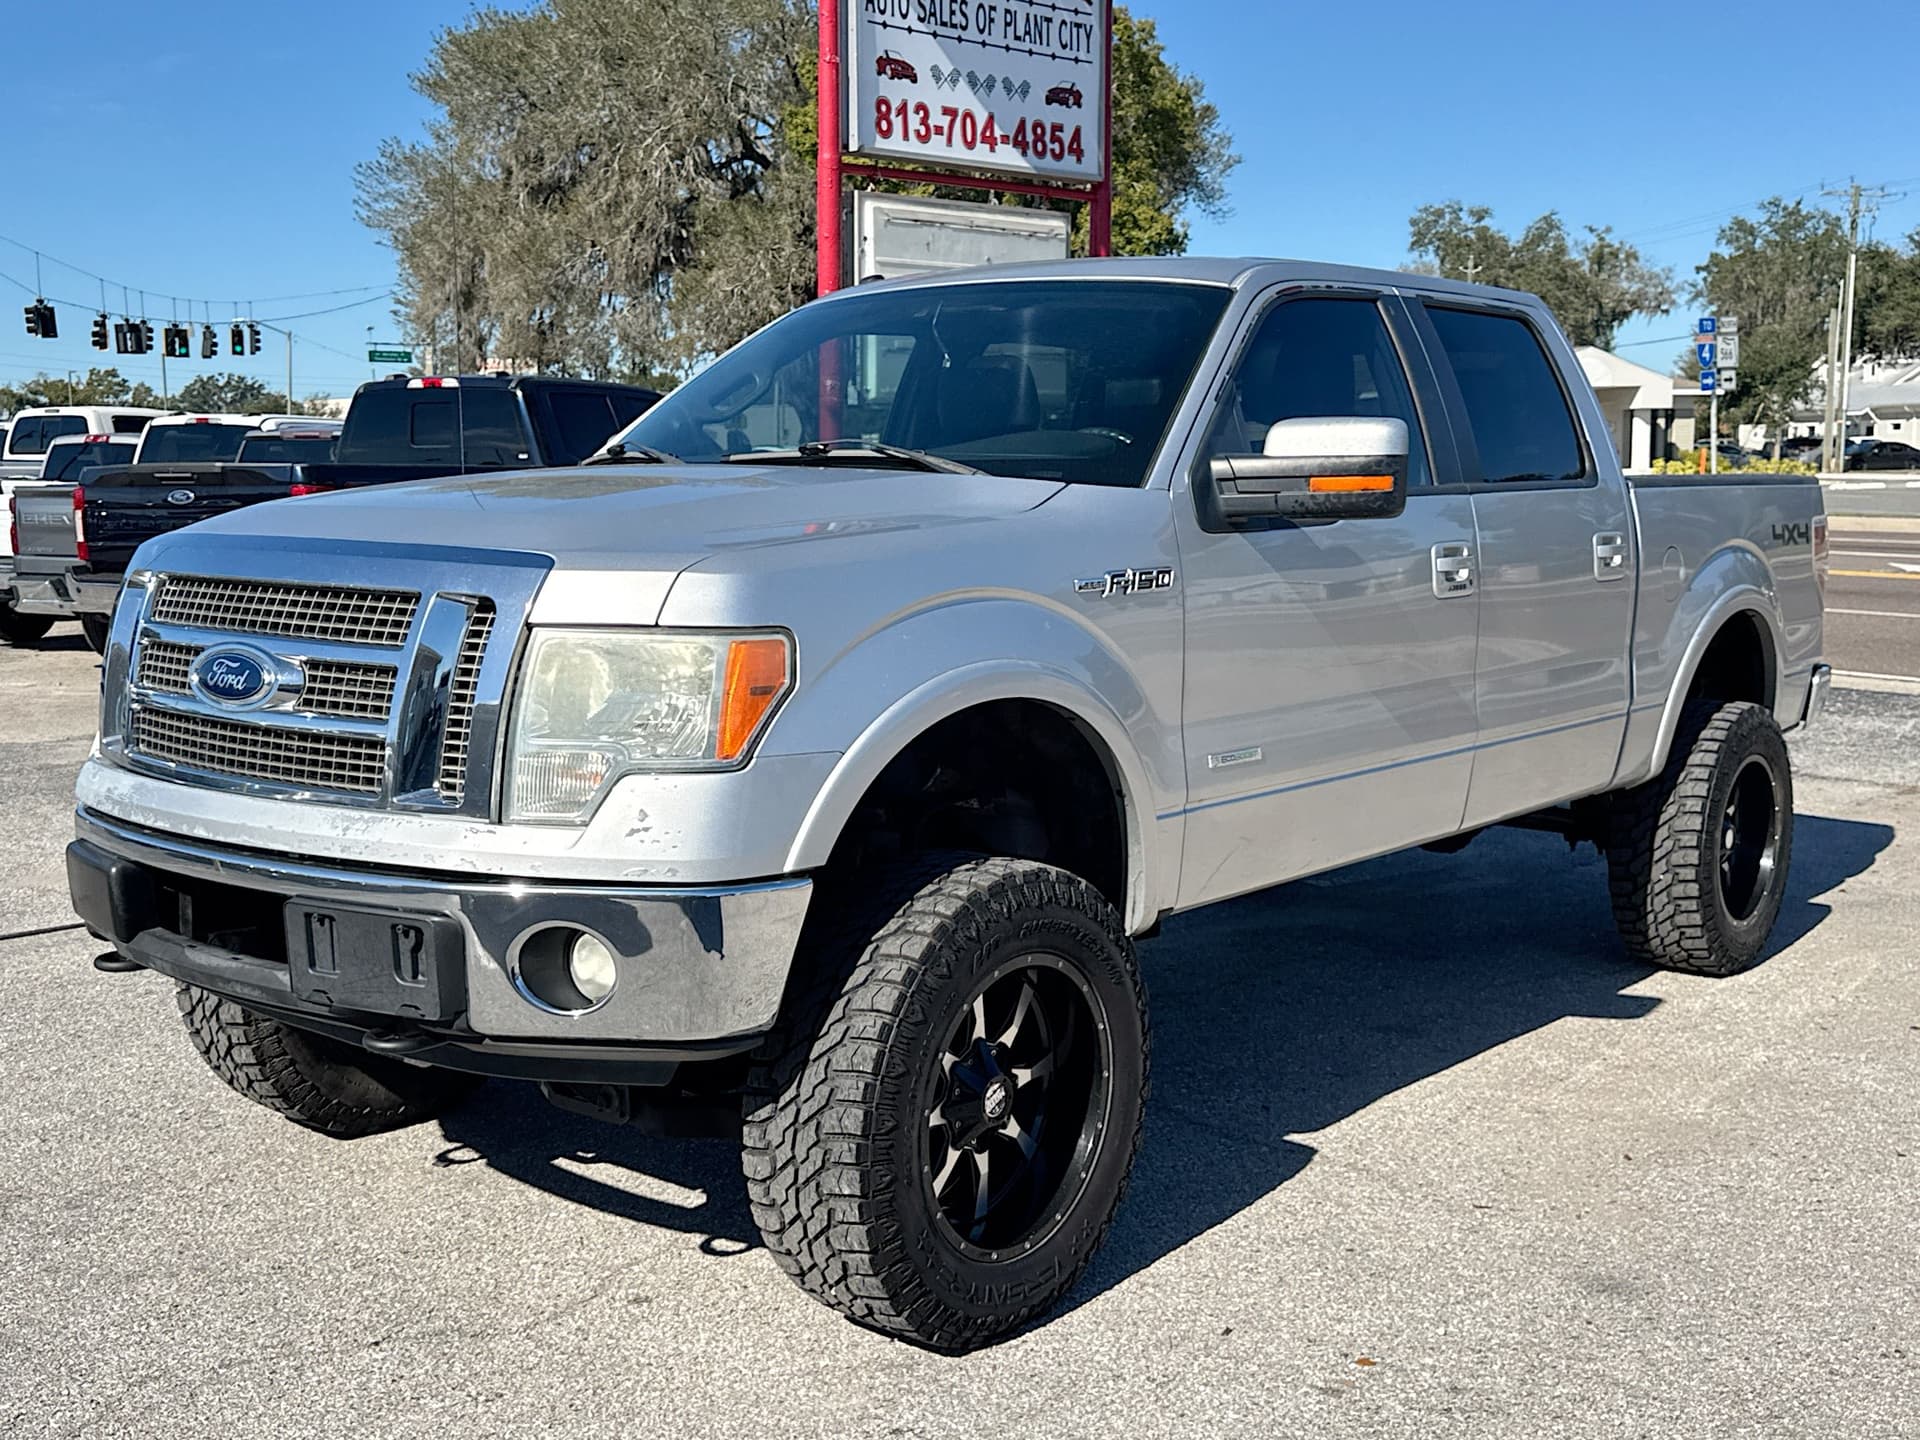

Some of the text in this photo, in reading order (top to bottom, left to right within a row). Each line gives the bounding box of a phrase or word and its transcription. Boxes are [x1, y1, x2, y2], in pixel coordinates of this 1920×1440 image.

[917, 0, 969, 31] SALES
[975, 2, 997, 36] OF
[1004, 8, 1053, 47] PLANT
[1058, 19, 1093, 54] CITY
[875, 95, 1085, 165] 813-704-4854
[1702, 343, 1711, 362] 4
[207, 658, 250, 690] Ford
